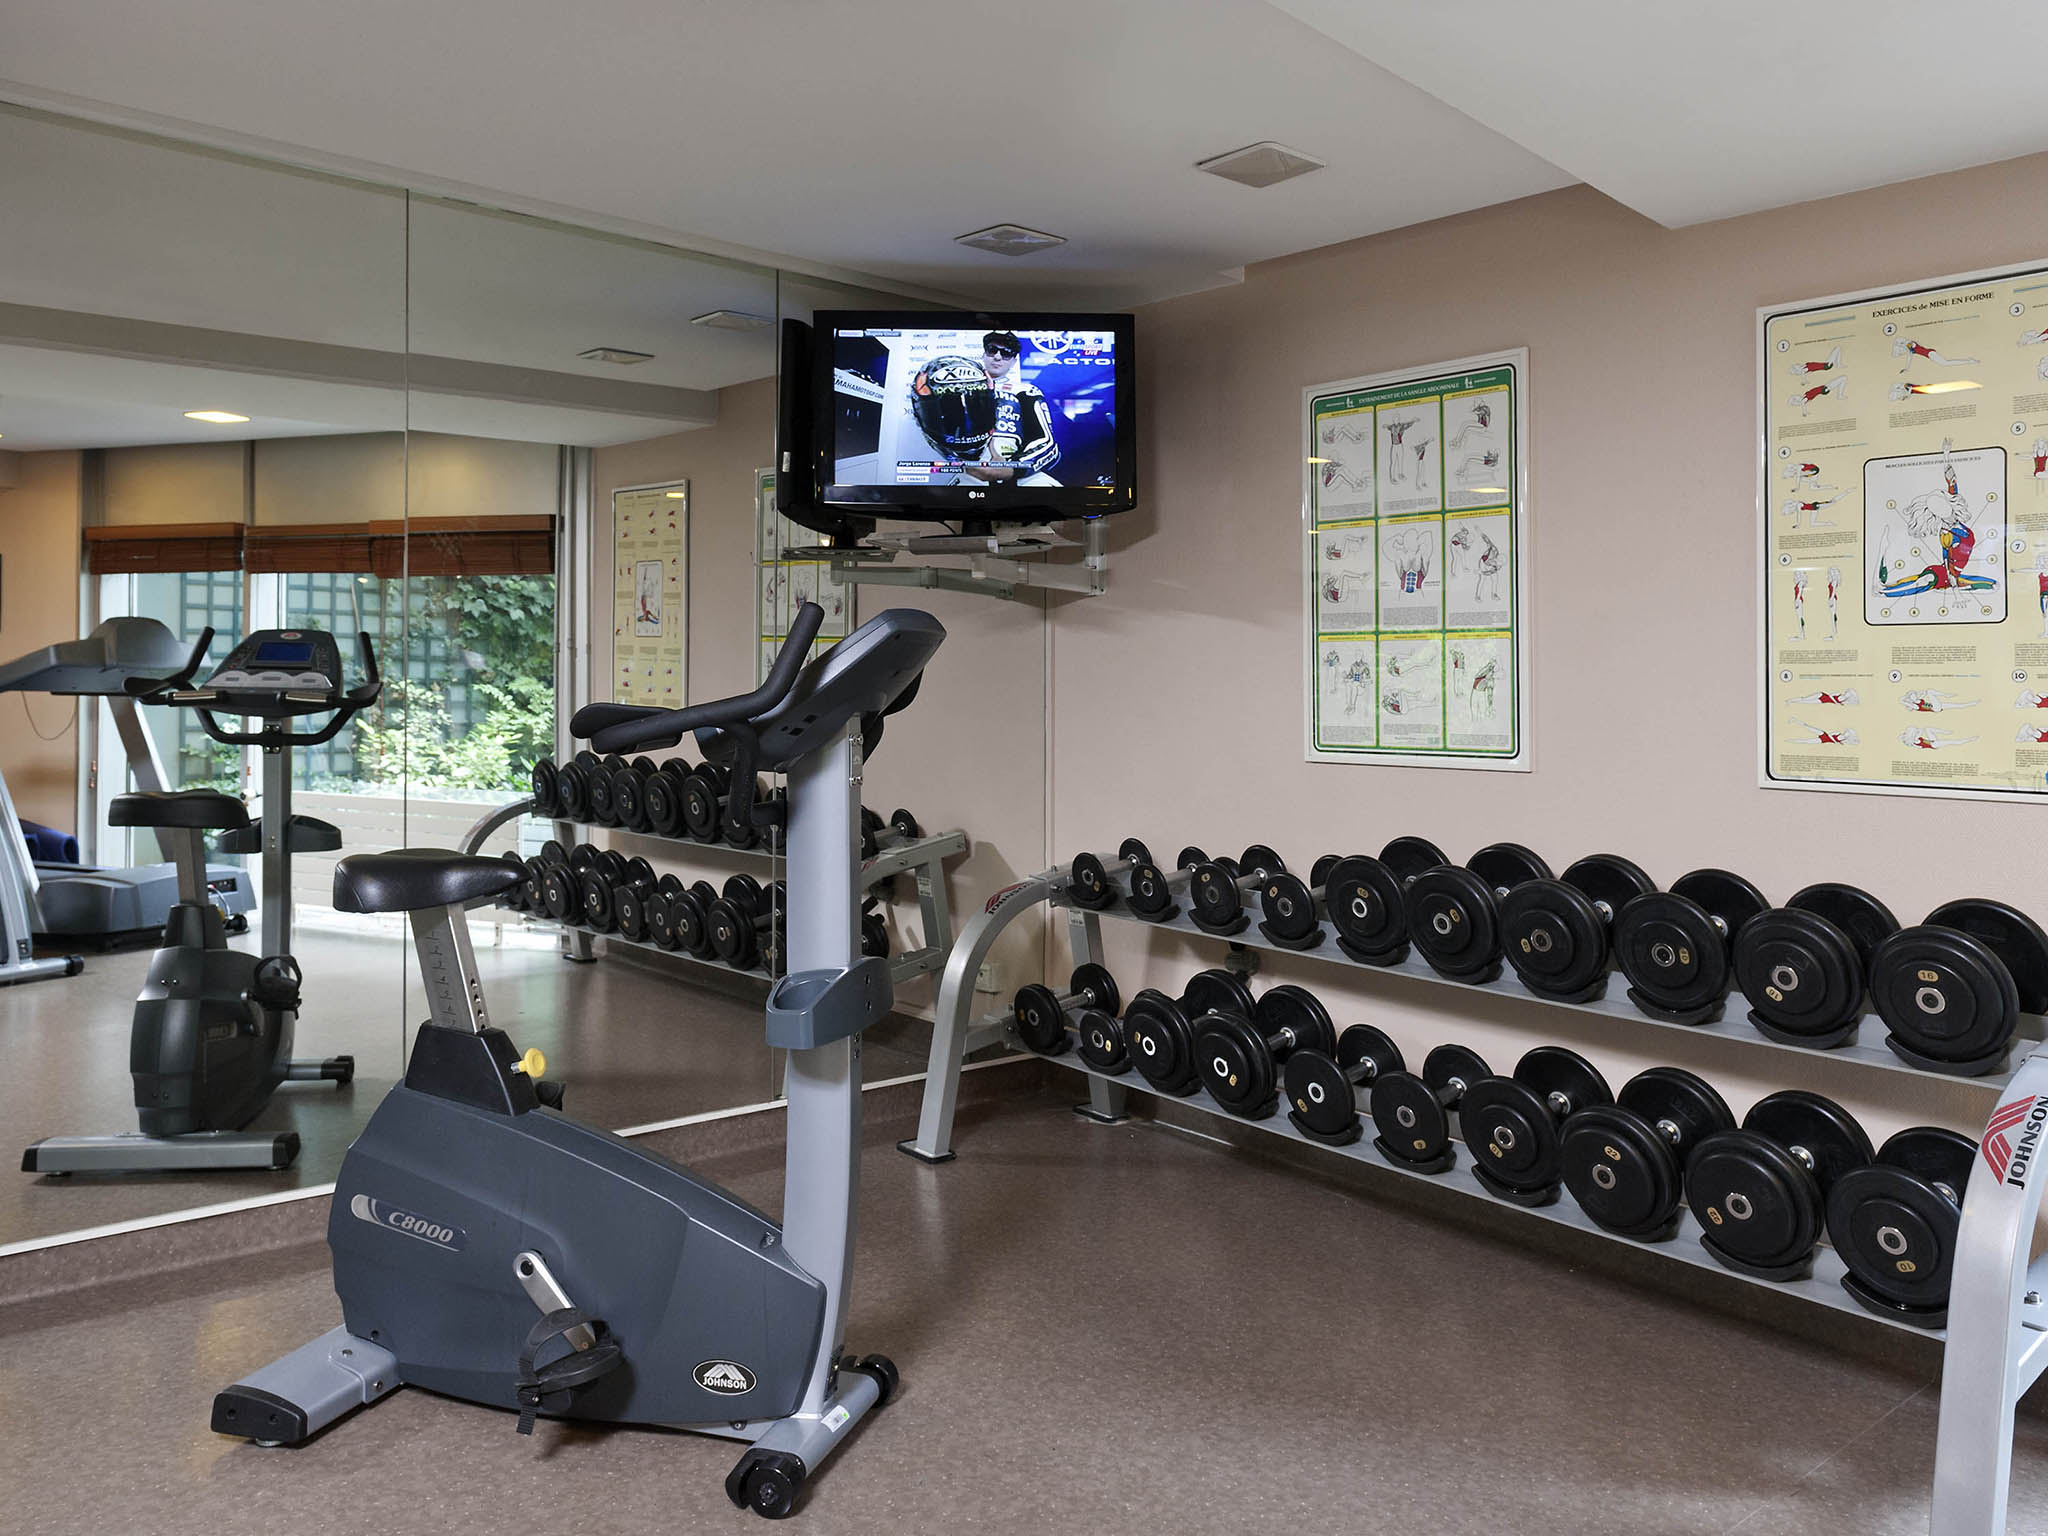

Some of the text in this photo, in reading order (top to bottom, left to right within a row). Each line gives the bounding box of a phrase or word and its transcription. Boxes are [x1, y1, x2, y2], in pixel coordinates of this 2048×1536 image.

[1872, 292, 1995, 318] EXERCICES de MISE EN FORME
[2007, 1096, 2048, 1191] JOHNSON
[388, 1211, 454, 1243] C8000
[702, 1376, 747, 1390] JOHNSON
